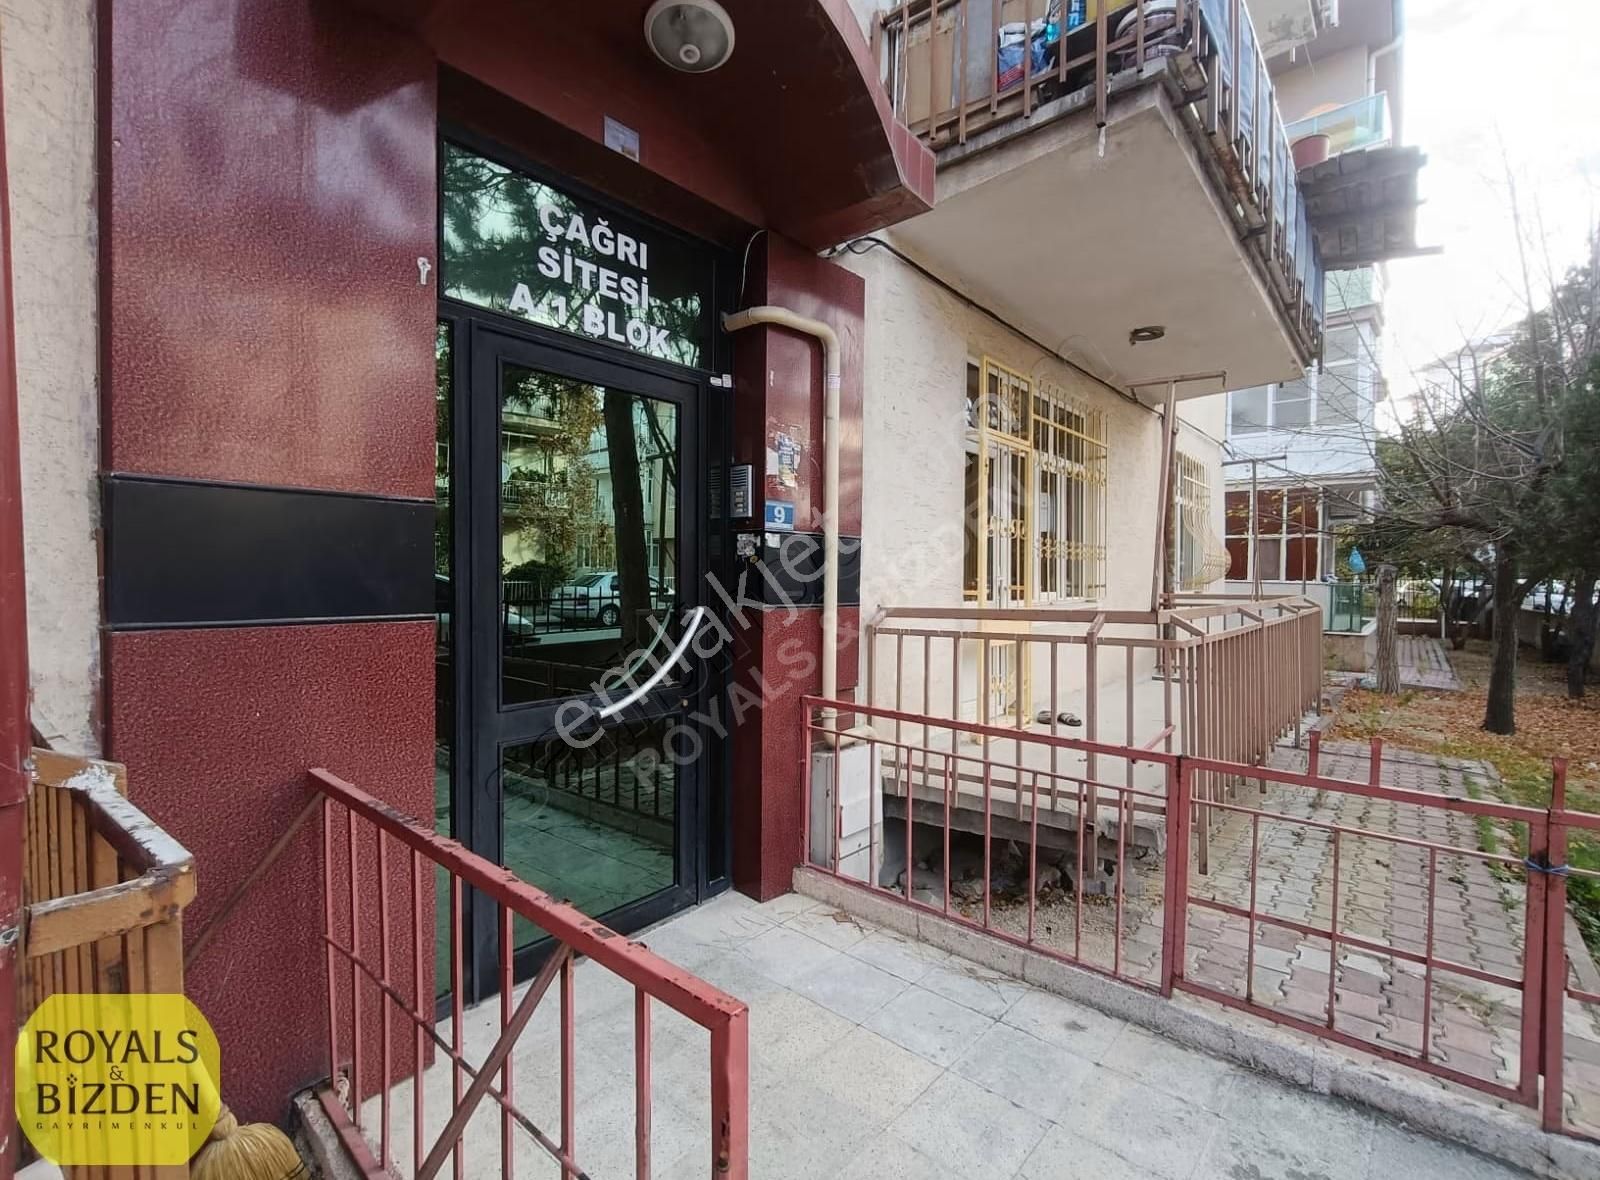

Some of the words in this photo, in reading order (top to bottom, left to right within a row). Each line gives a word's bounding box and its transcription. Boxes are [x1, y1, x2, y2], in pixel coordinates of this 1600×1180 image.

[539, 203, 648, 270] ÇAĞRI
[537, 246, 649, 310] SİTESİ
[584, 303, 671, 351] BLOK
[774, 506, 785, 523] 9
